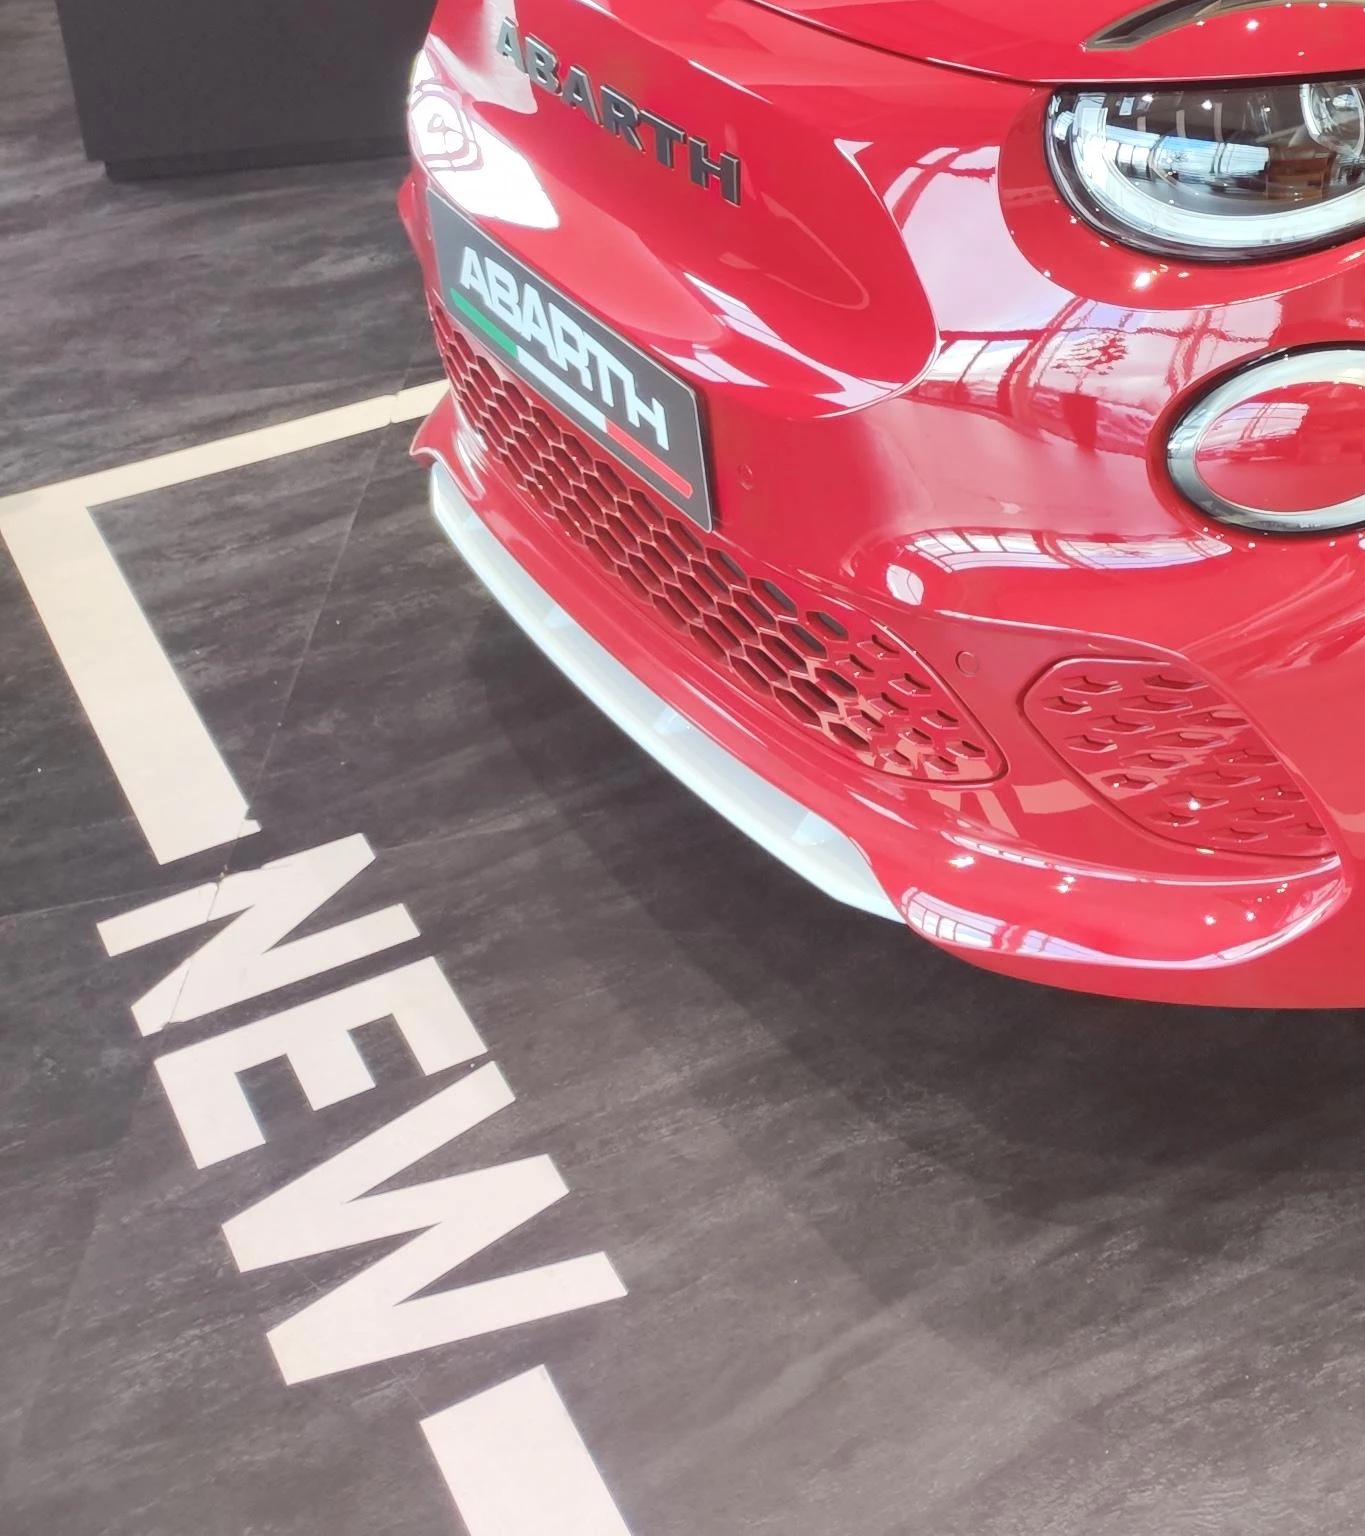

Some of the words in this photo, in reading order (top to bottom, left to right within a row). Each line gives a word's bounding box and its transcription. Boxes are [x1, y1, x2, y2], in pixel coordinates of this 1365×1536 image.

[495, 15, 742, 207] ABARTH
[459, 245, 670, 451] ABARTH
[96, 832, 628, 1385] NEW
